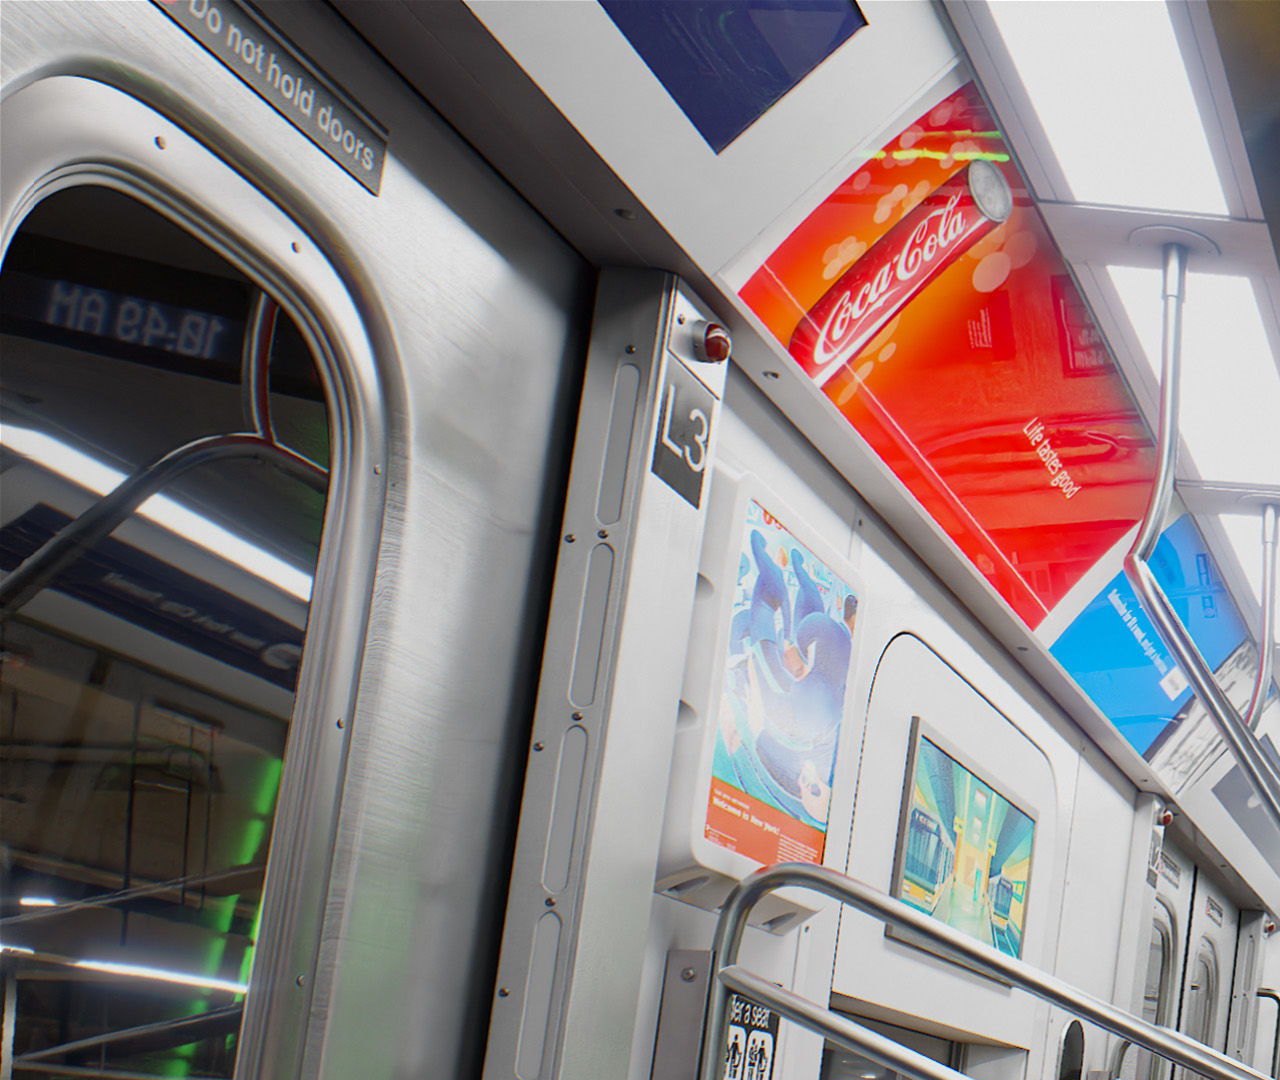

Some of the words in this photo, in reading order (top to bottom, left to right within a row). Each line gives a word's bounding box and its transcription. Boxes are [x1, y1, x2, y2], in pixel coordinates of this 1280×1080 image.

[189, 0, 222, 34] Do
[227, 24, 265, 74] not
[266, 53, 316, 117] hold
[318, 106, 375, 171] doors
[813, 190, 967, 365] Coca-Cola
[661, 383, 710, 472] L3
[1023, 416, 1045, 446] Life
[1037, 439, 1063, 475] tastes
[1050, 470, 1083, 499] good
[744, 1003, 751, 1024] a
